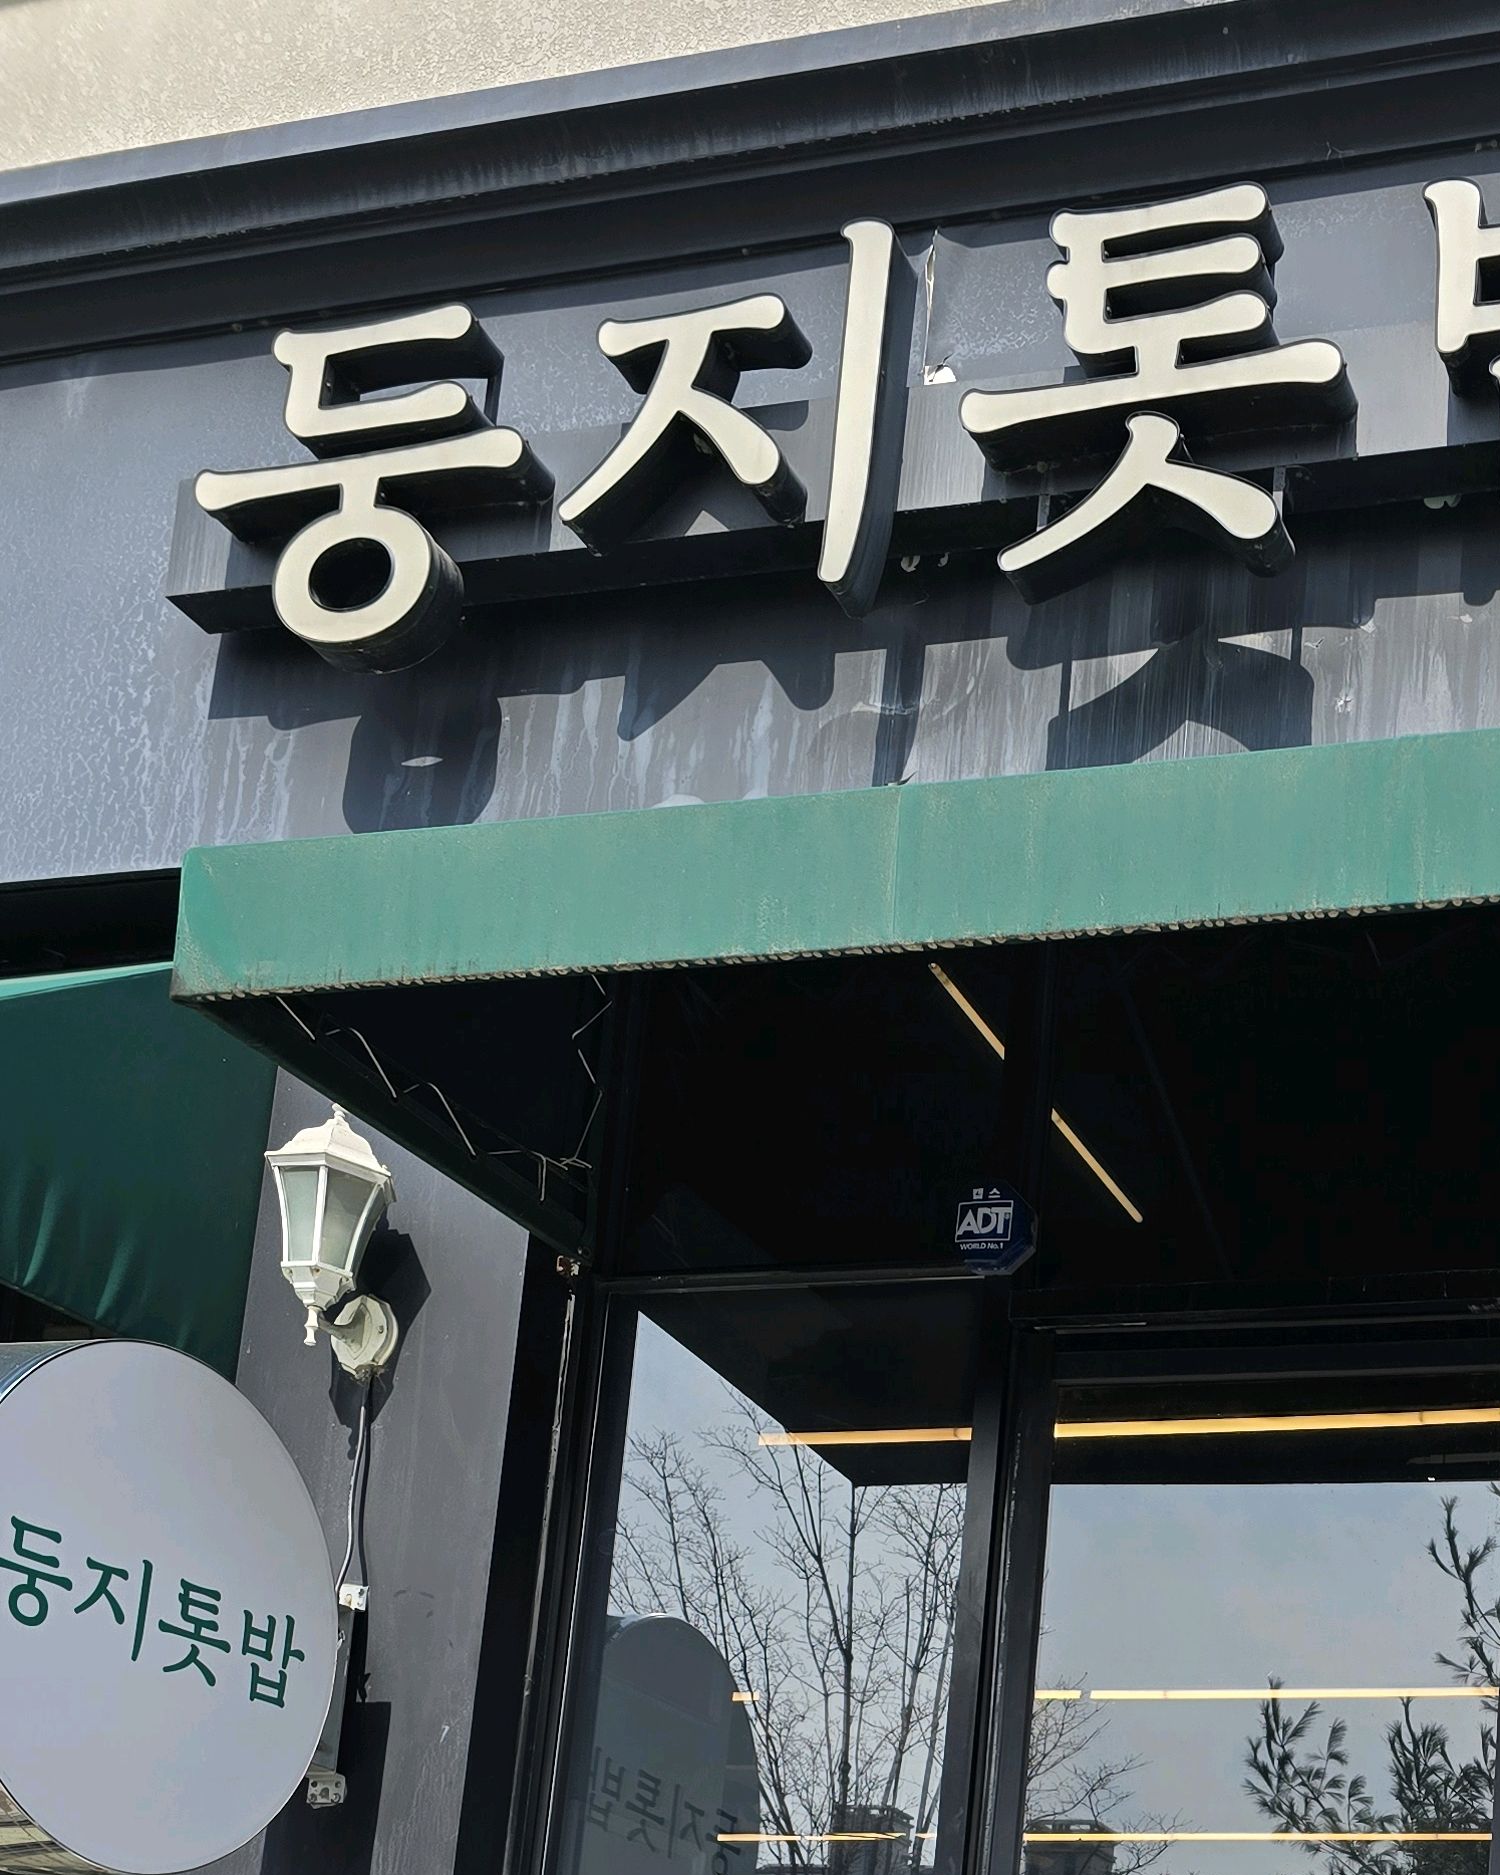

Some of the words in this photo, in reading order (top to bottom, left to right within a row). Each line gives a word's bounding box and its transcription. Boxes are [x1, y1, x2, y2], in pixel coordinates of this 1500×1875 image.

[956, 1207, 1012, 1236] ADT
[960, 1242, 986, 1250] WORLD
[0, 1515, 305, 1708] 둥지톳밥
